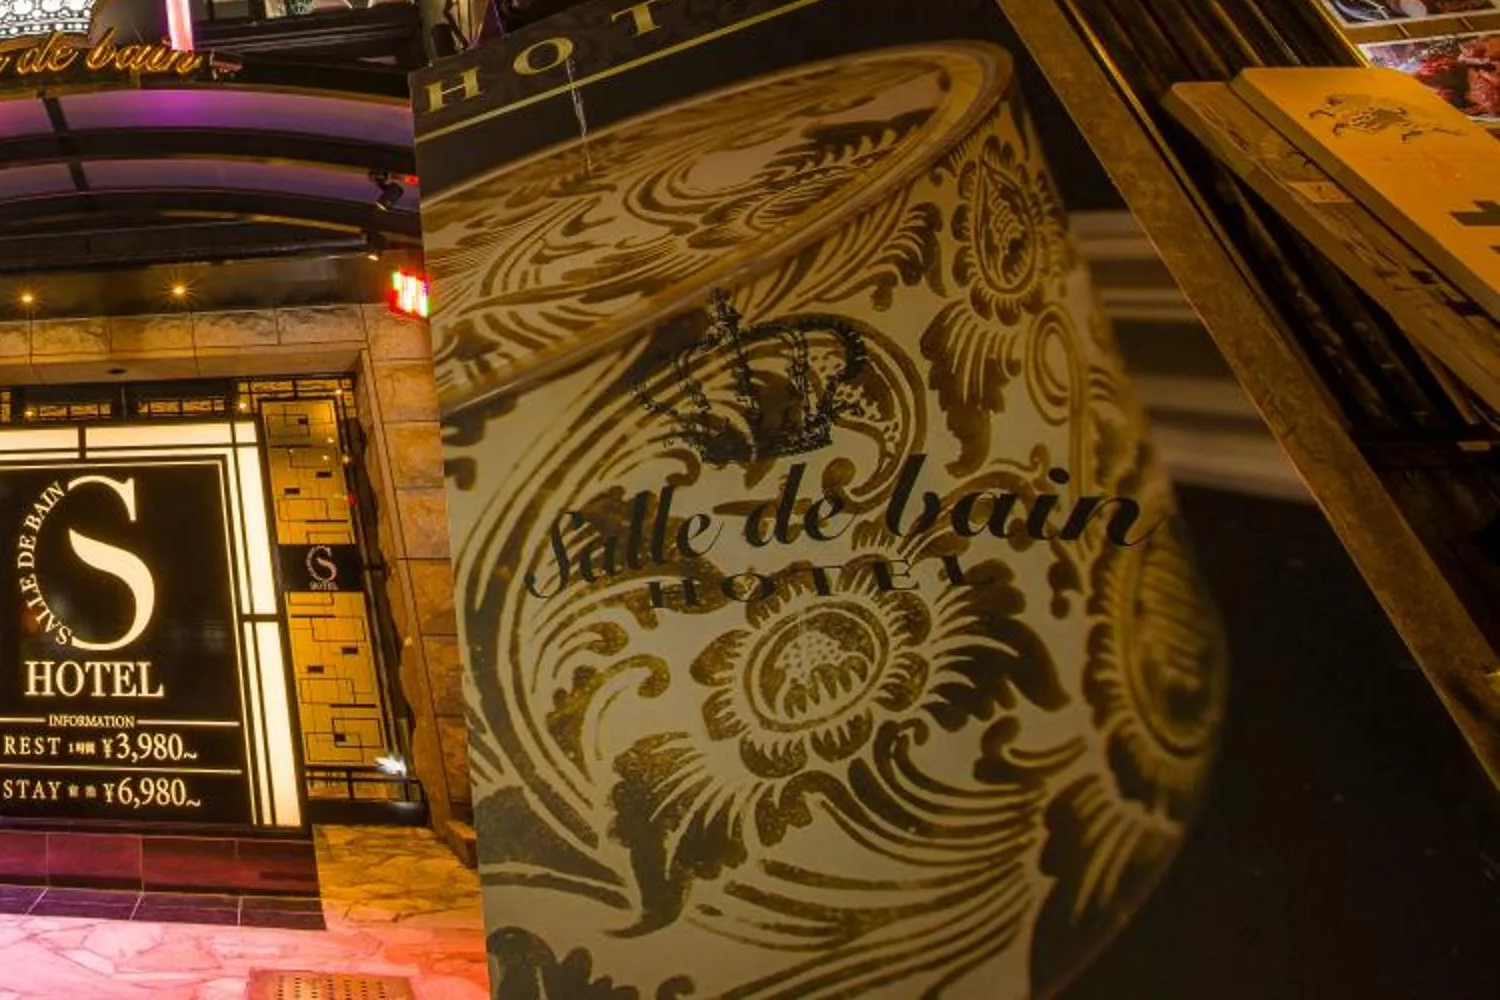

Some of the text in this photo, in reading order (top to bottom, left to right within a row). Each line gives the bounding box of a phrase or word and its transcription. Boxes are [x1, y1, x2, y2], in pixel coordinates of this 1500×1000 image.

[17, 30, 79, 76] de
[86, 26, 202, 77] bain
[523, 453, 1168, 600] Salle de bain
[17, 480, 72, 645] SALLE DE BAIN
[647, 555, 997, 609] HOTEL
[24, 660, 165, 698] HOTEL
[48, 713, 135, 729] INFORMATION
[3, 734, 62, 756] REST
[3, 778, 62, 799] STAY
